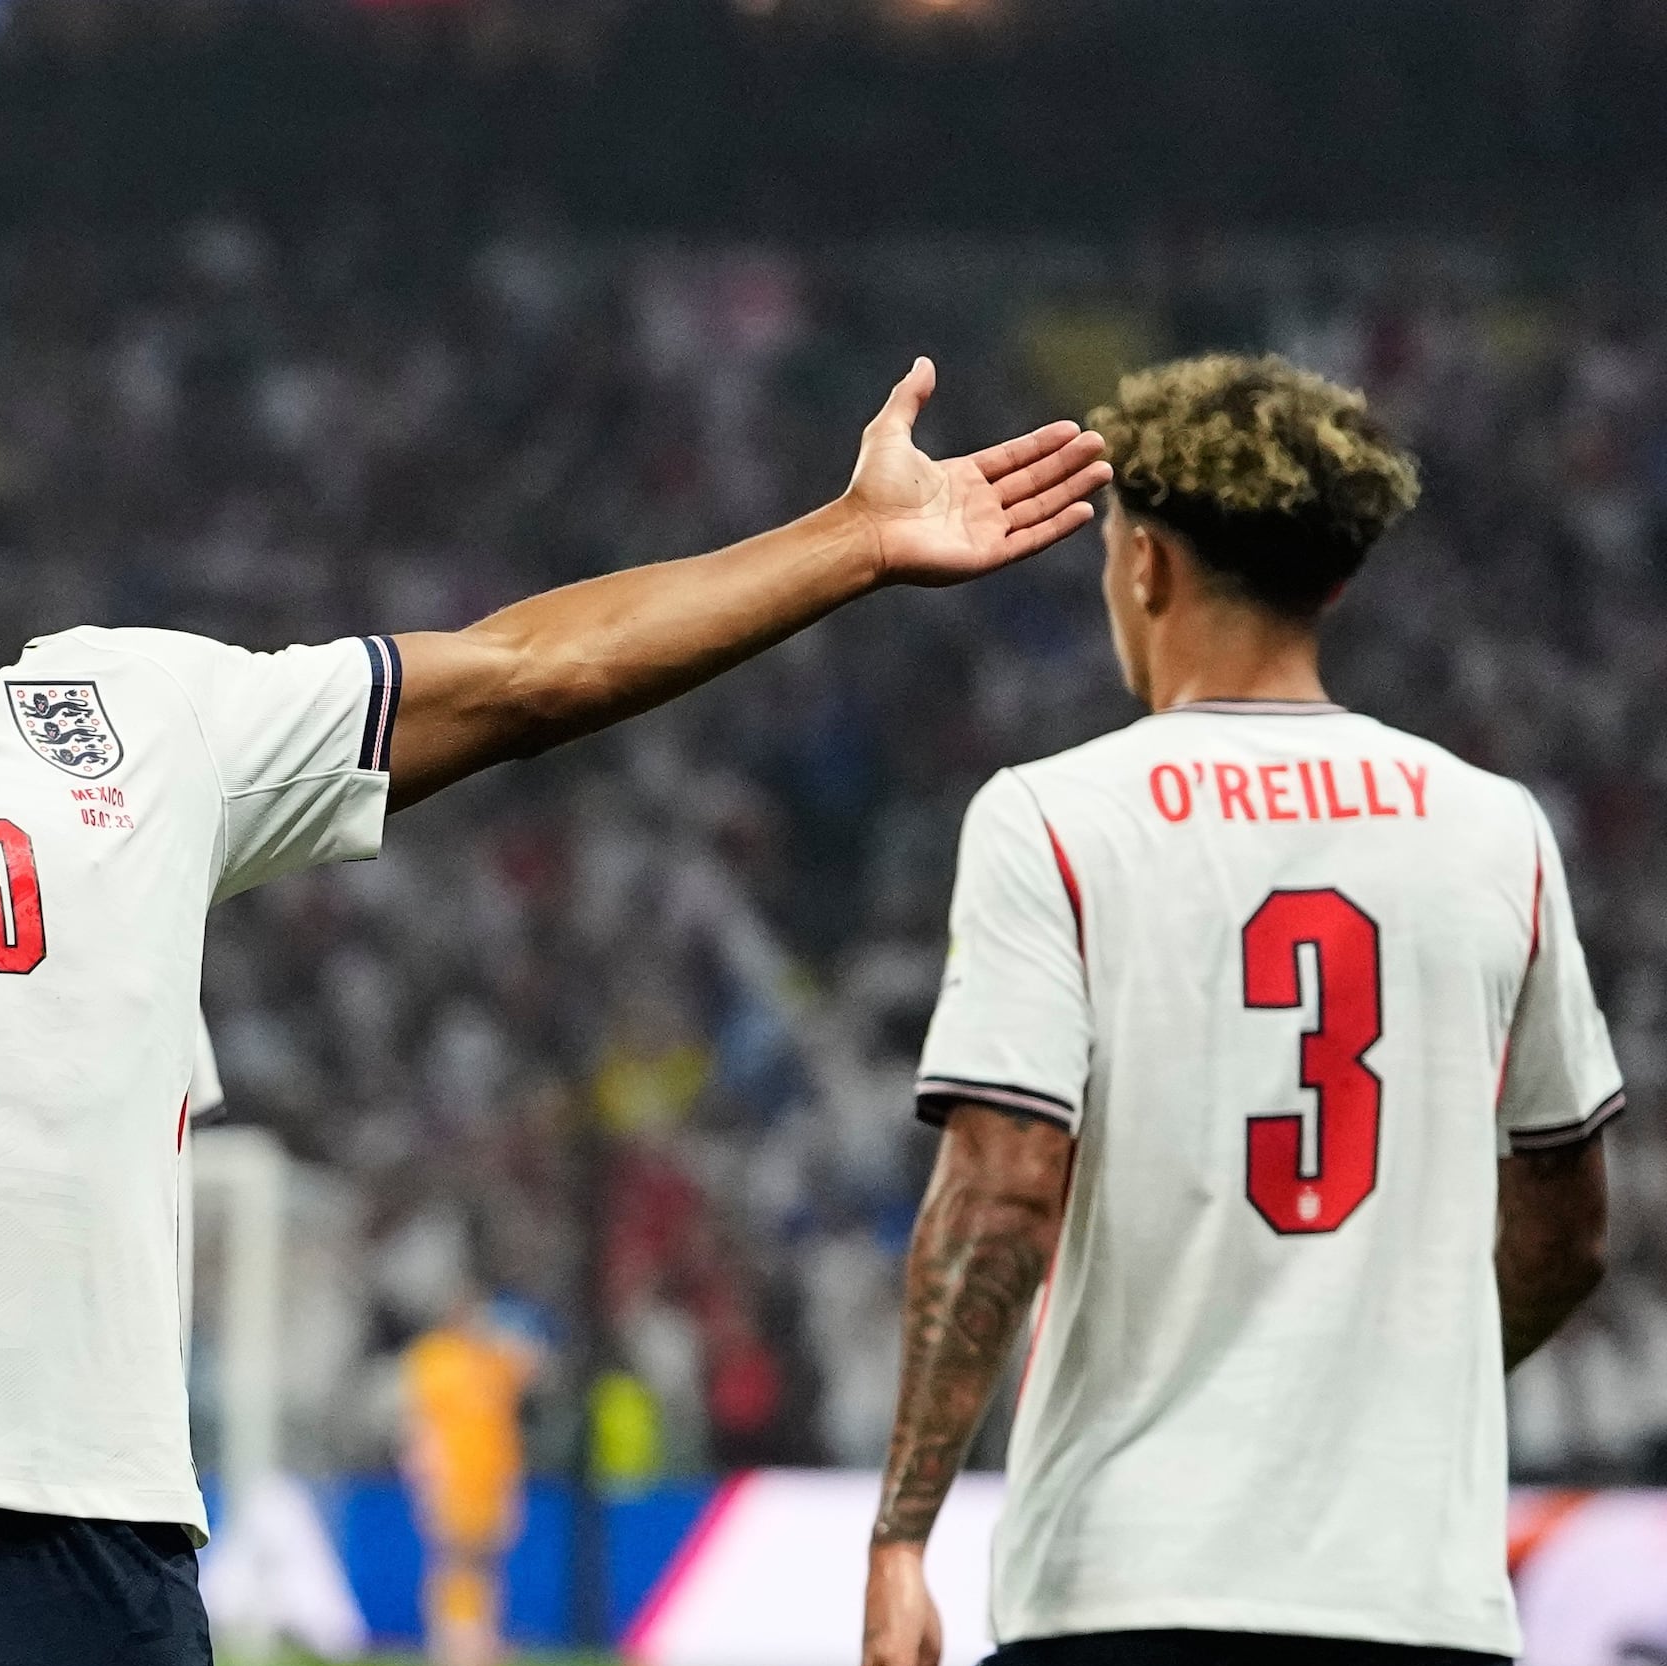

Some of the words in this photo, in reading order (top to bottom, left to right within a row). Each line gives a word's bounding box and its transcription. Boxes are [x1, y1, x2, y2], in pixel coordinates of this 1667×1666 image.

[70, 786, 124, 808] MEXICO
[1149, 760, 1427, 823] O'REILLY
[1242, 887, 1381, 1236] 3
